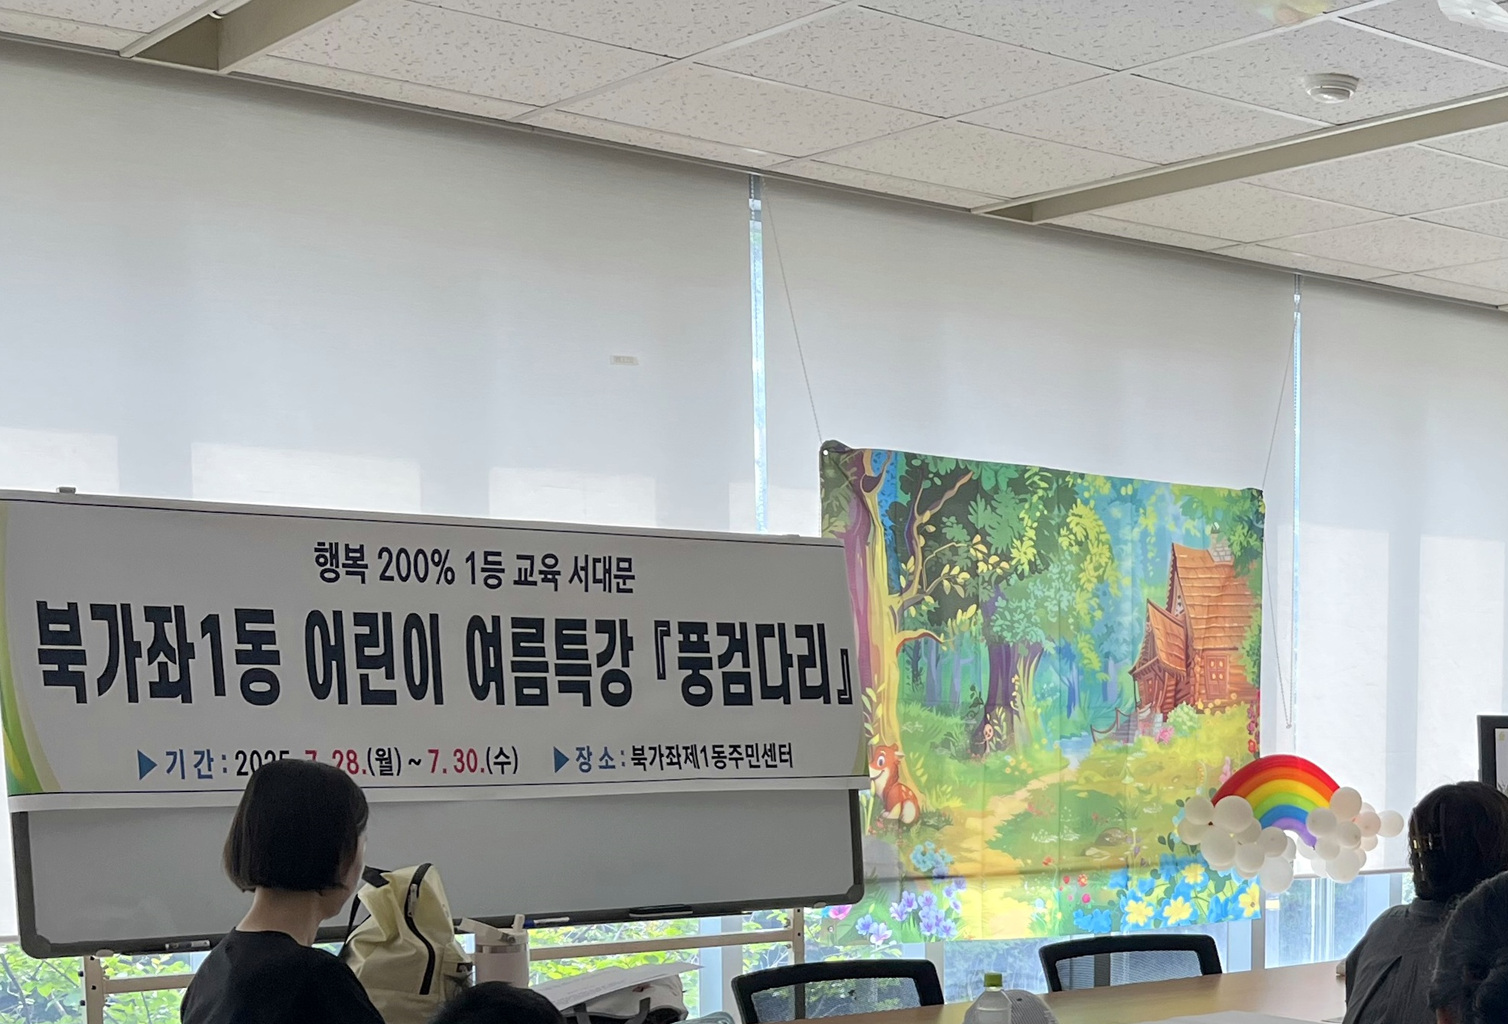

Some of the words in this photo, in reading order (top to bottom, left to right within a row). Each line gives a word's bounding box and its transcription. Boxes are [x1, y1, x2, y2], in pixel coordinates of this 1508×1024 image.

[314, 541, 369, 585] 행복
[377, 546, 456, 585] 200%
[465, 550, 506, 590] 1등
[513, 553, 562, 592] 교육
[568, 554, 636, 594] 서대문
[36, 600, 282, 707] 북가좌1동
[305, 609, 445, 706] 어린이
[466, 614, 635, 708] 여름특강
[630, 742, 794, 772] 북가좌제1동주민센터
